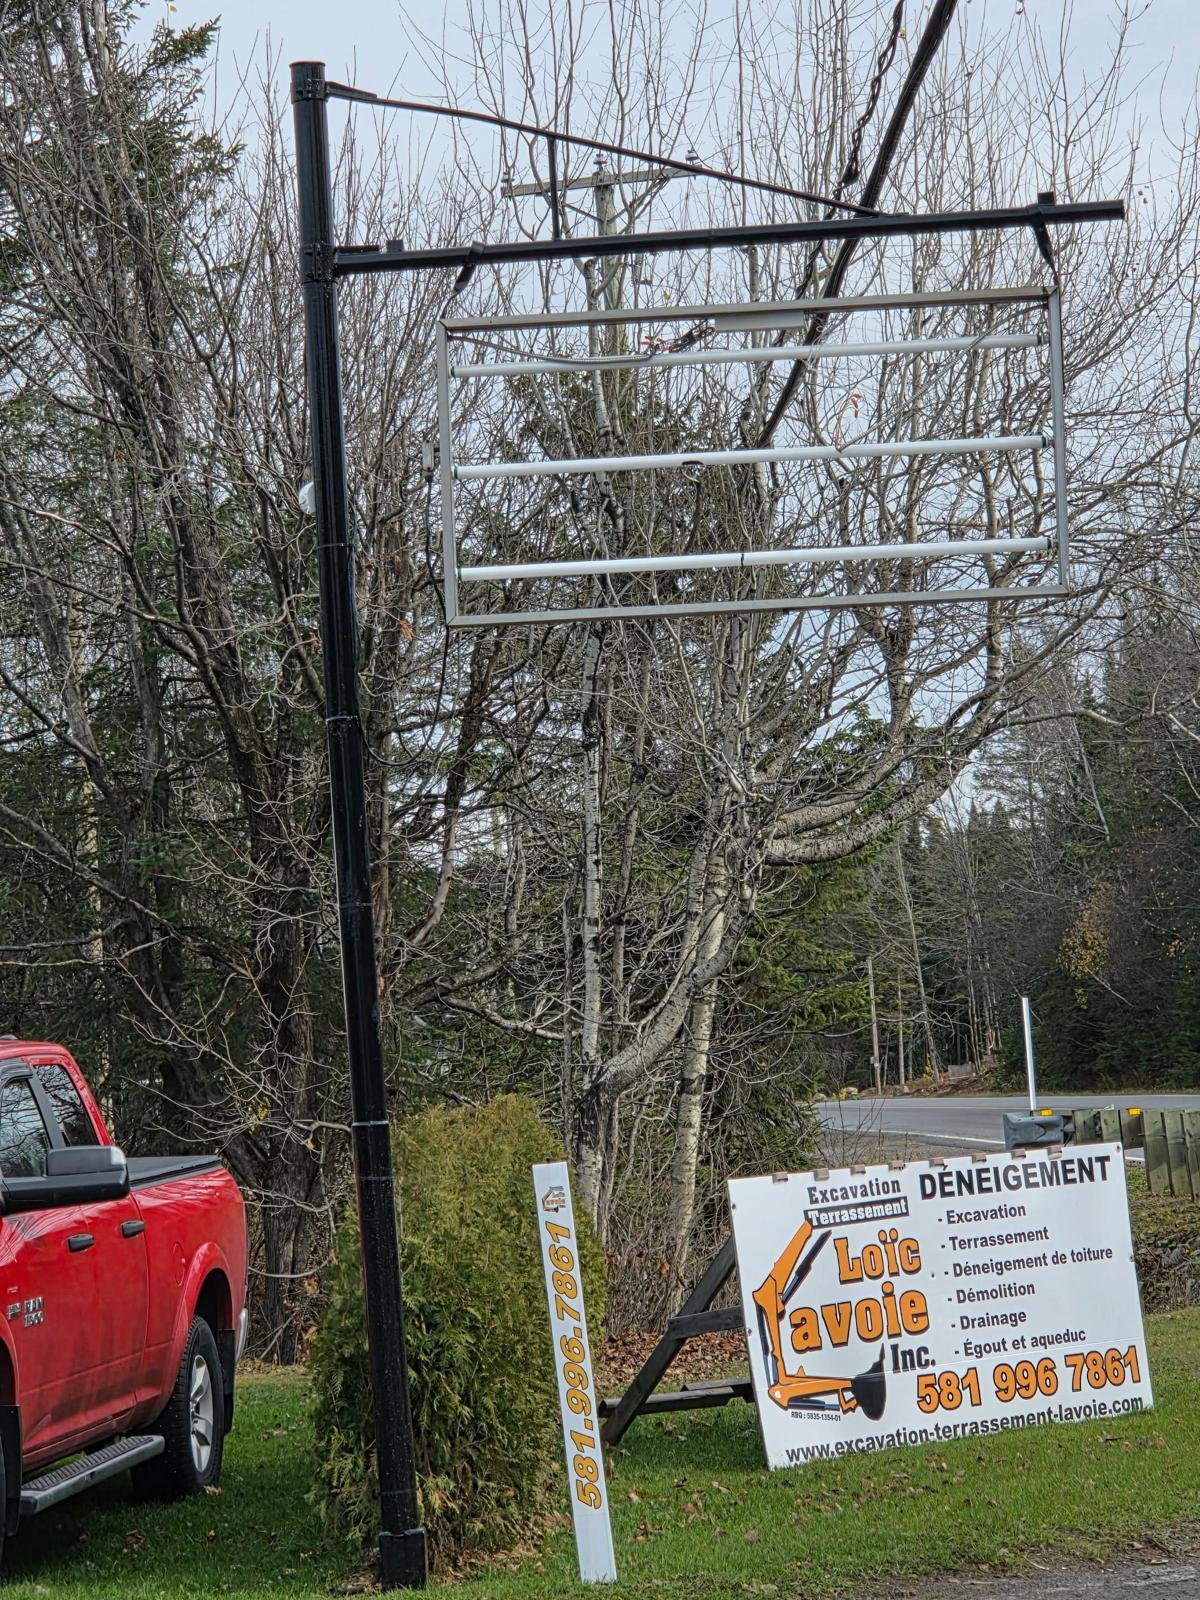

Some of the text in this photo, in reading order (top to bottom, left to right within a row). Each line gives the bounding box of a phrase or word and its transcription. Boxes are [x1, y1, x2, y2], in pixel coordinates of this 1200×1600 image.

[807, 1178, 902, 1204] Excavation
[919, 1155, 1111, 1201] DÉNEIGEMENT
[808, 1199, 907, 1226] Terrassement
[946, 1204, 1026, 1225] Excavation
[949, 1226, 1050, 1251] Terrassement
[833, 1228, 921, 1285] Loïc
[952, 1248, 1113, 1278] Déneigement de toiture
[956, 1282, 1036, 1304] Démolition
[959, 1311, 1027, 1330] Drainage
[963, 1329, 1086, 1358] Égout et aqueduc
[545, 1220, 602, 1510] 581.996.7861
[890, 1343, 936, 1374] Inc.
[916, 1345, 1141, 1414] 581 996 7861
[785, 1396, 1144, 1463] www.excavation-terrassement-lavoie.com
